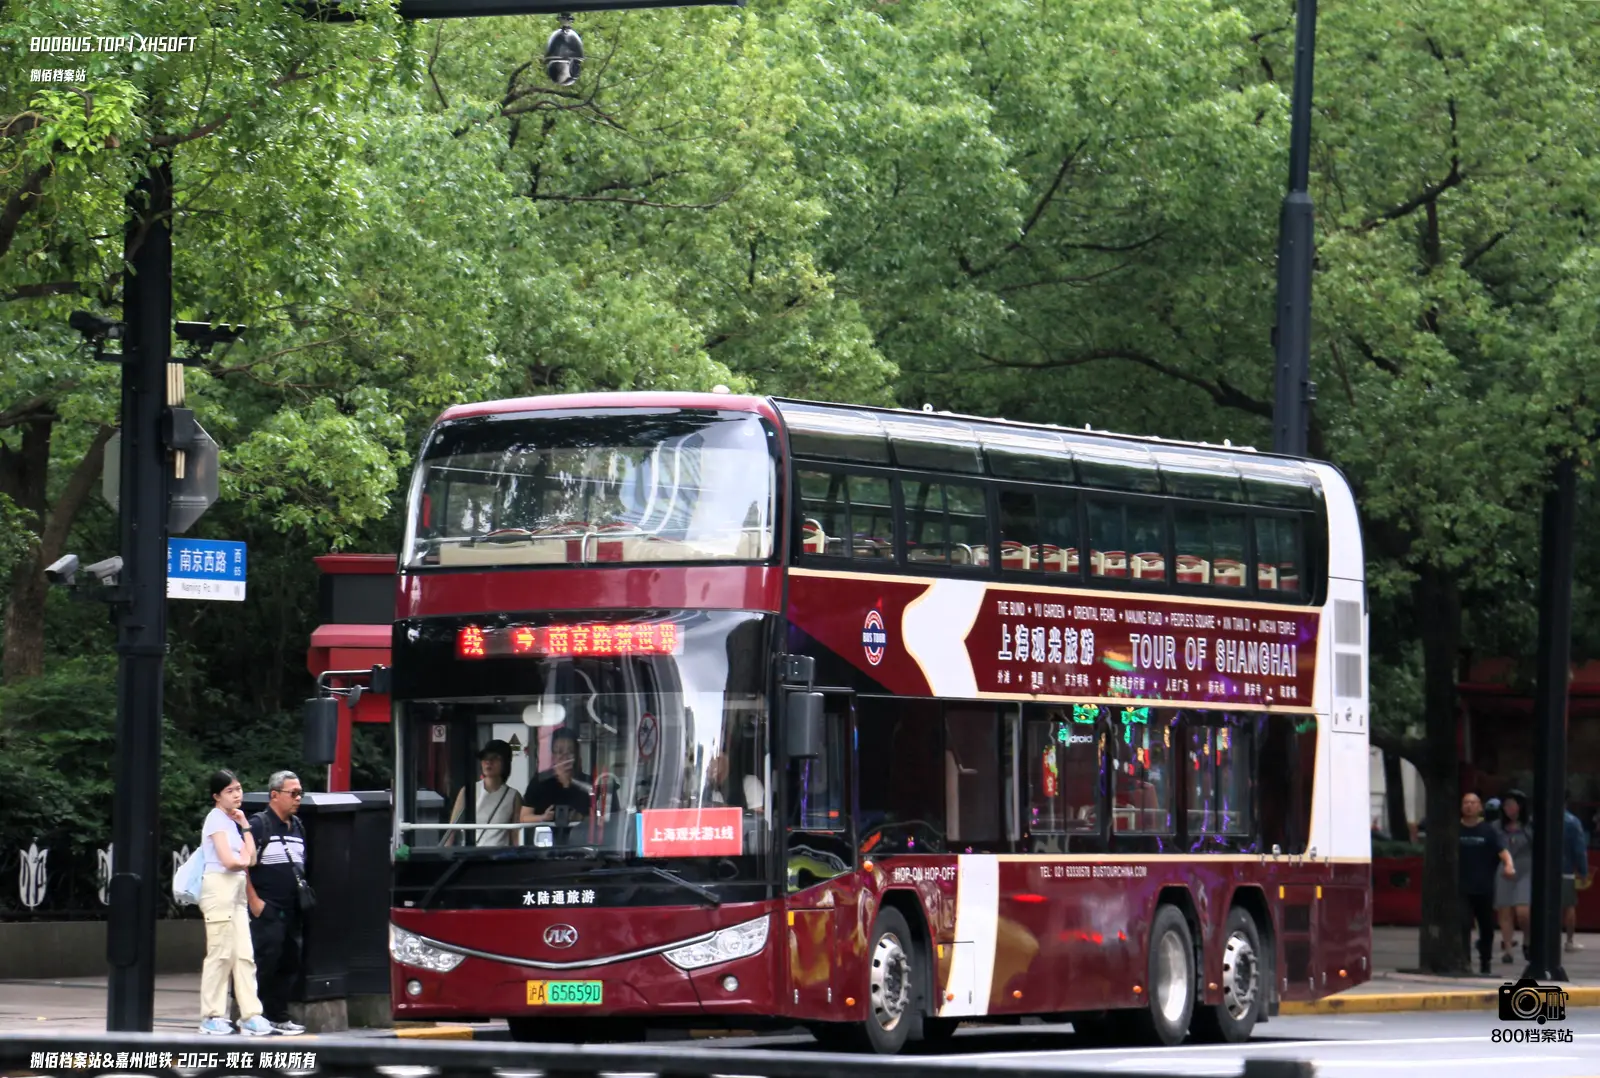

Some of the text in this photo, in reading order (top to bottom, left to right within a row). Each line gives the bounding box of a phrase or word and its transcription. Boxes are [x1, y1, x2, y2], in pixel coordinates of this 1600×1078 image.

[180, 548, 227, 573] 南京西路
[998, 623, 1094, 666] 上海观光旅游
[1129, 633, 1297, 677] TOUR OF SHANGHAI
[895, 866, 955, 881] HOP-ON HOP-OFF
[523, 889, 595, 905] 水陆通旅游
